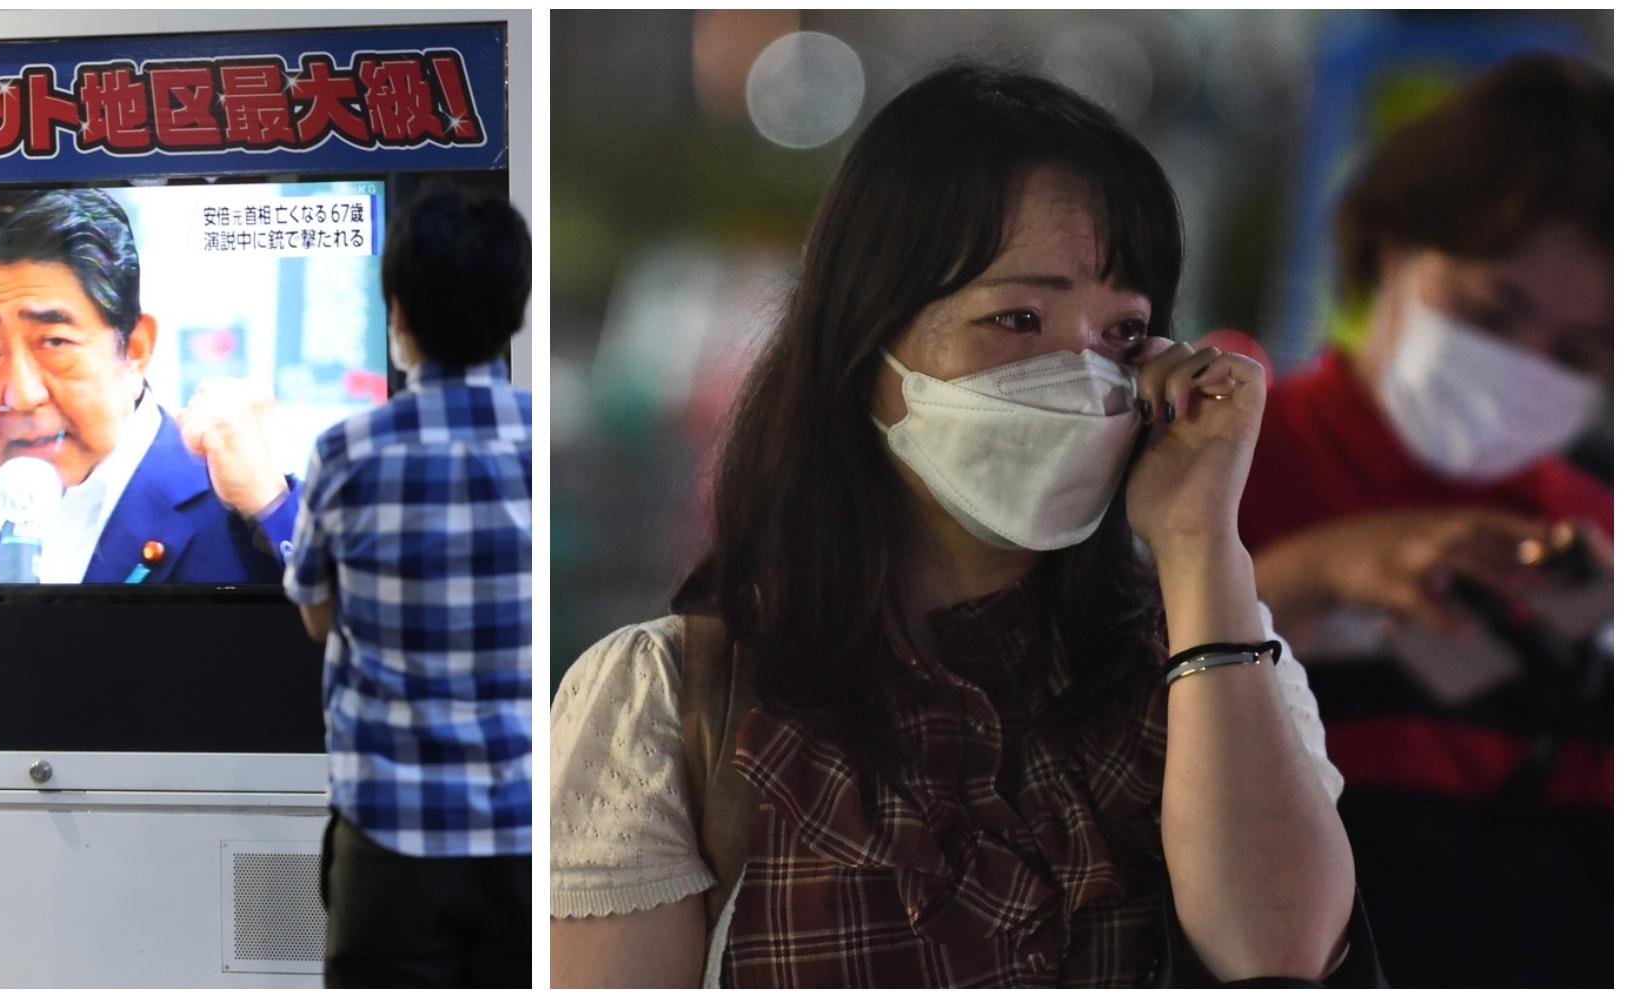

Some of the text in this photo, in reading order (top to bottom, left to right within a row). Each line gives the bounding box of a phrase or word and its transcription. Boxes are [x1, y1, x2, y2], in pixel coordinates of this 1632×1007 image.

[203, 228, 365, 252] 演説中に銃で撃たれる
